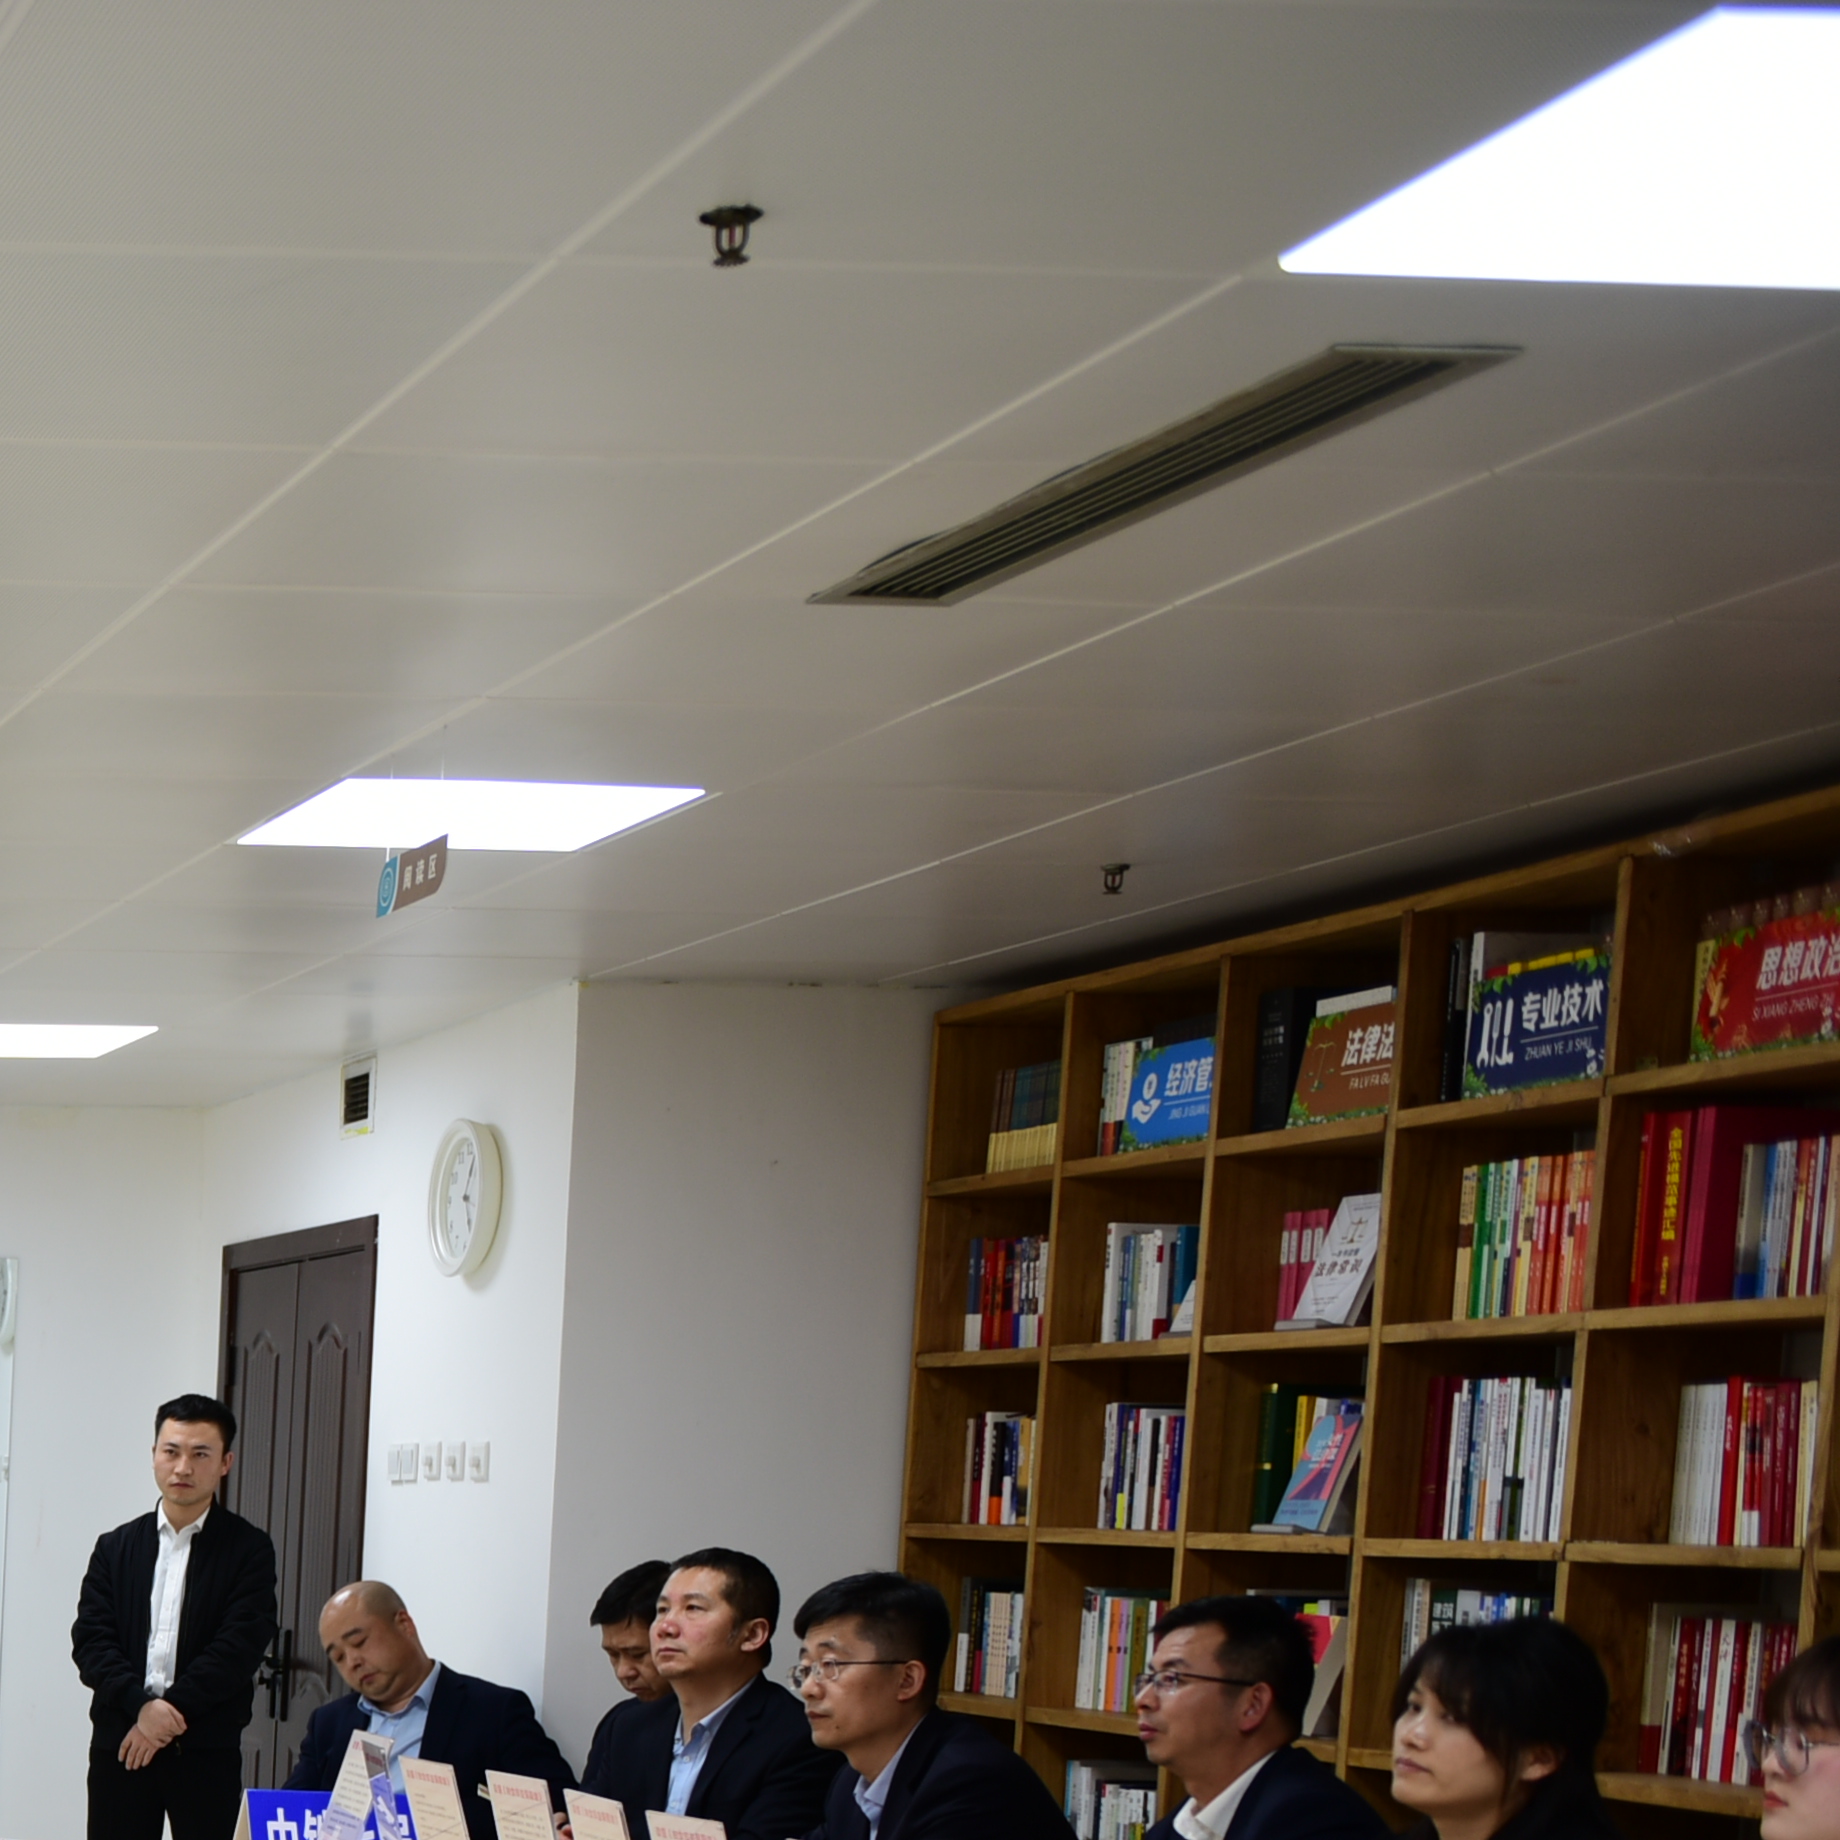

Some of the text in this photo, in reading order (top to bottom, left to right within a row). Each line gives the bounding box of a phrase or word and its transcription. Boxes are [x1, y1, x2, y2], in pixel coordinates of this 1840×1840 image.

[1521, 979, 1604, 1032] 专业技术
[1164, 1050, 1213, 1097] 经济管
[1524, 1042, 1552, 1062] ZHUAN
[1553, 1042, 1564, 1056] YE
